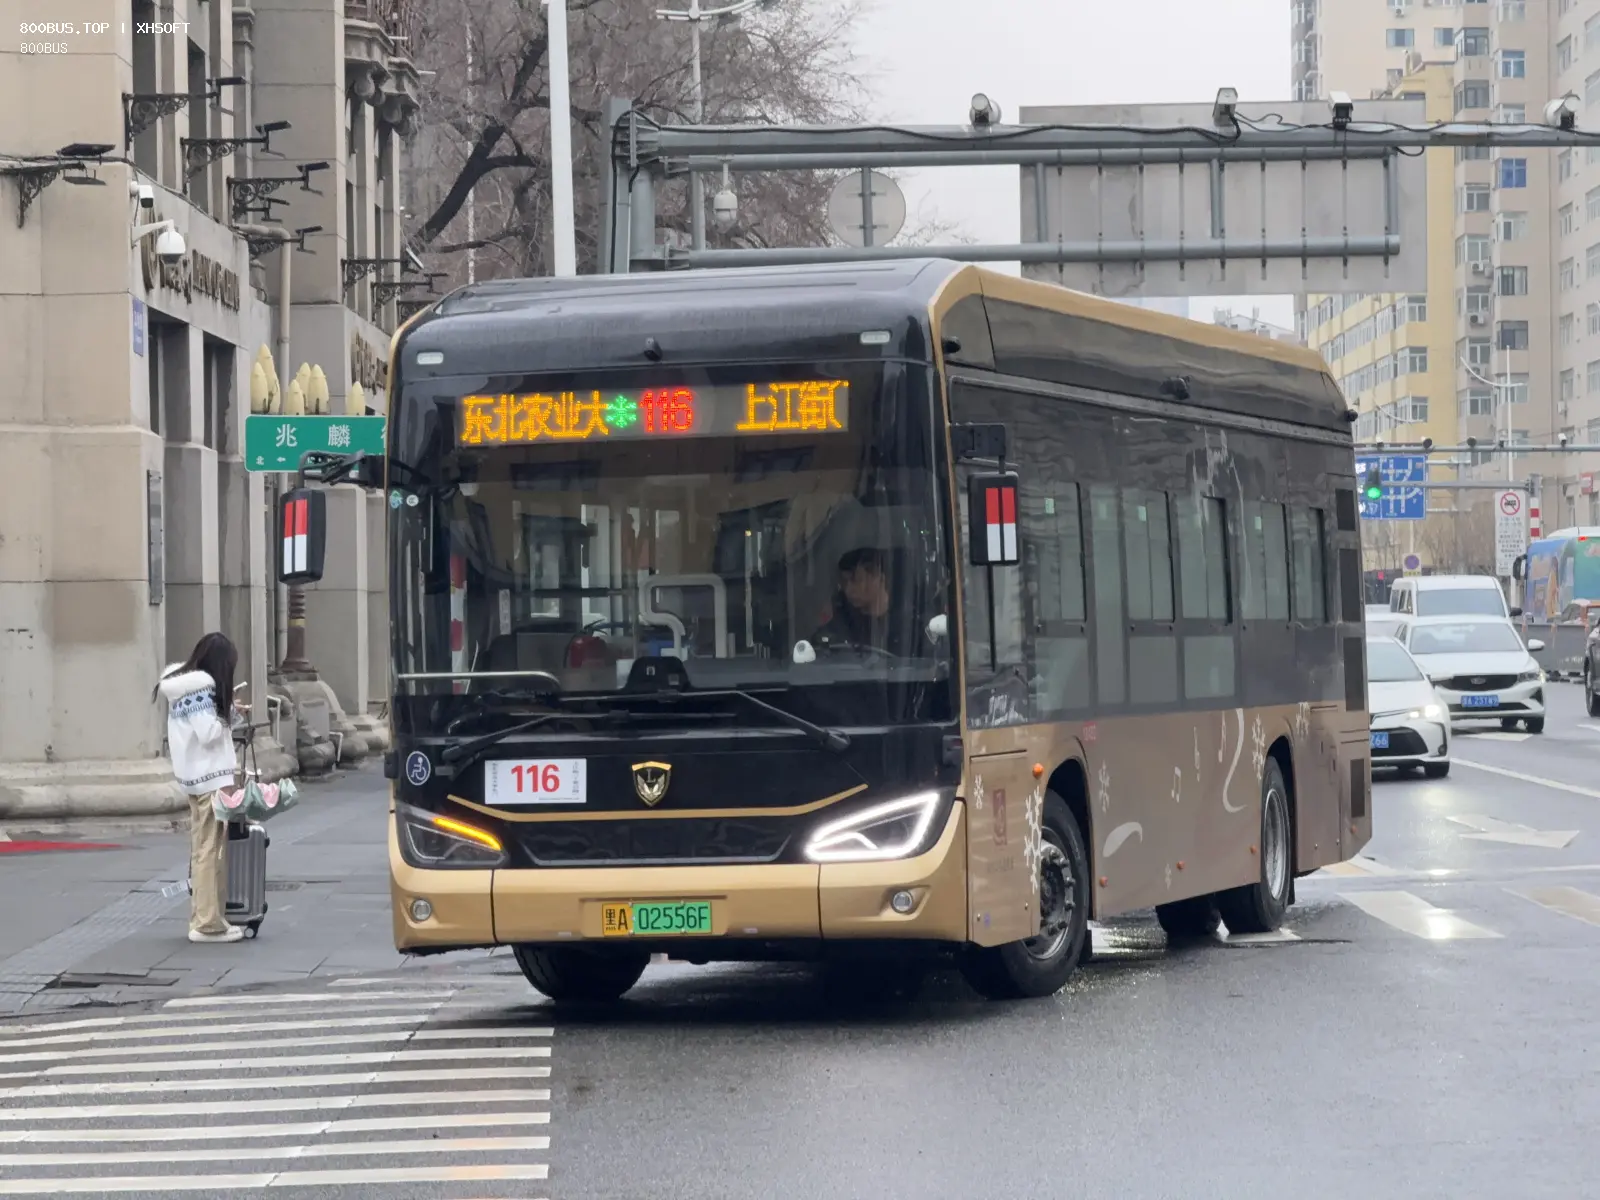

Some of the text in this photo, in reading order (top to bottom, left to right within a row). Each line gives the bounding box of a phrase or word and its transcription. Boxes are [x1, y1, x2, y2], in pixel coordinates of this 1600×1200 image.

[461, 390, 609, 444] 东北农业大
[640, 387, 694, 432] 116
[510, 763, 560, 793] 116
[605, 906, 709, 931] 黑A 02556F
